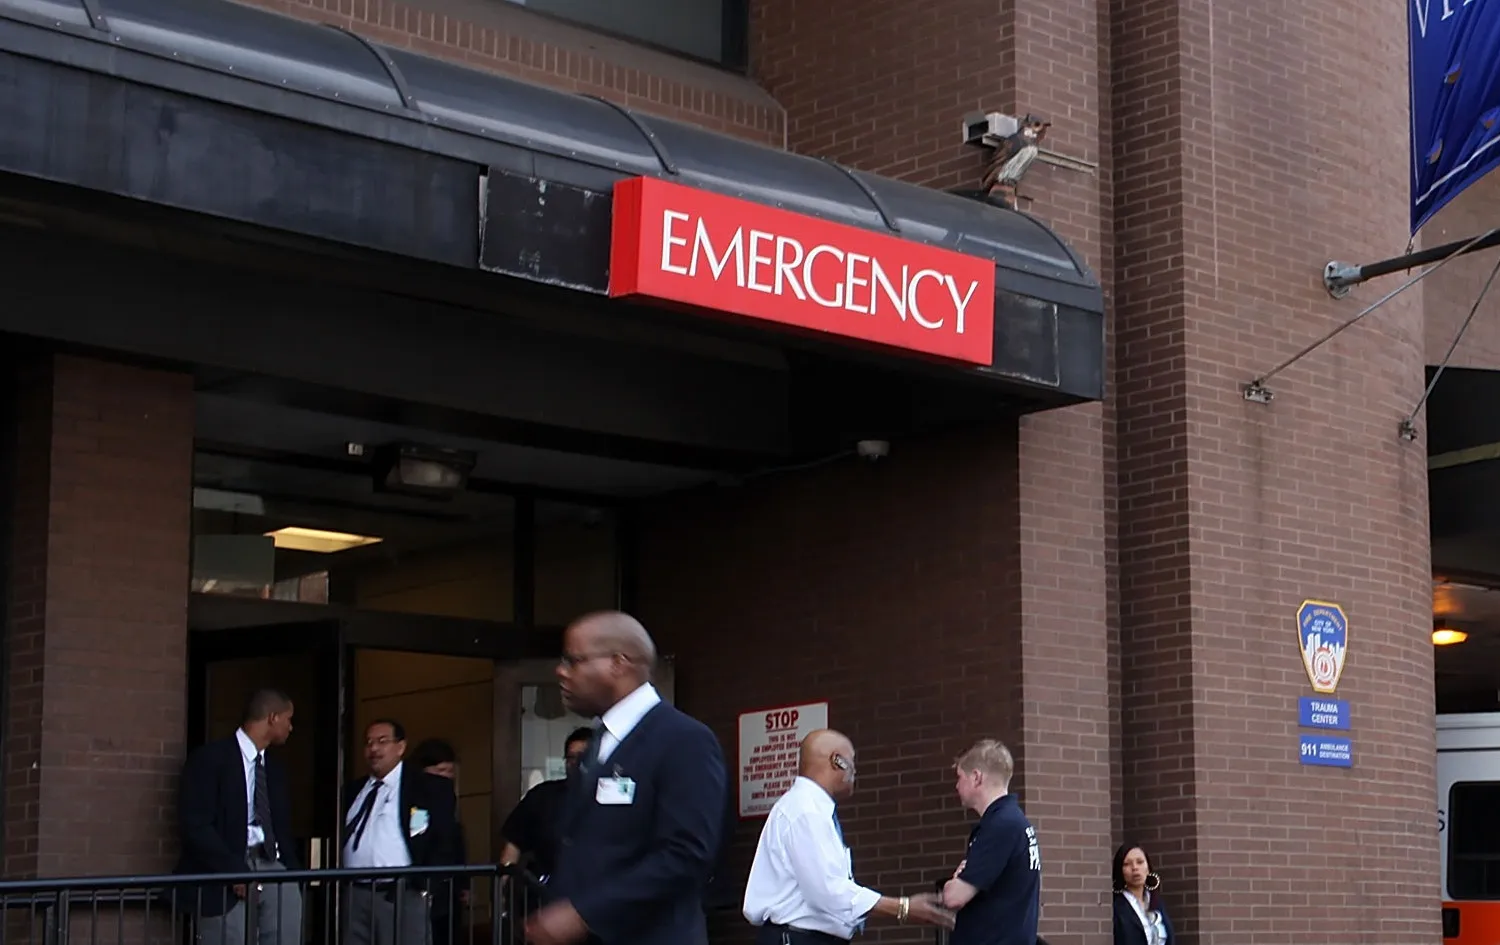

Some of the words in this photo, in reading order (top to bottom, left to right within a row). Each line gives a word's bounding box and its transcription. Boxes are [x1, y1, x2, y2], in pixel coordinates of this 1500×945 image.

[660, 209, 979, 334] EMERGENCY
[1311, 701, 1338, 713] TRAUMA
[765, 711, 799, 729] STOP
[1311, 713, 1338, 725] CENTER
[1301, 742, 1317, 756] 911
[1320, 743, 1348, 752] AMBULANCE
